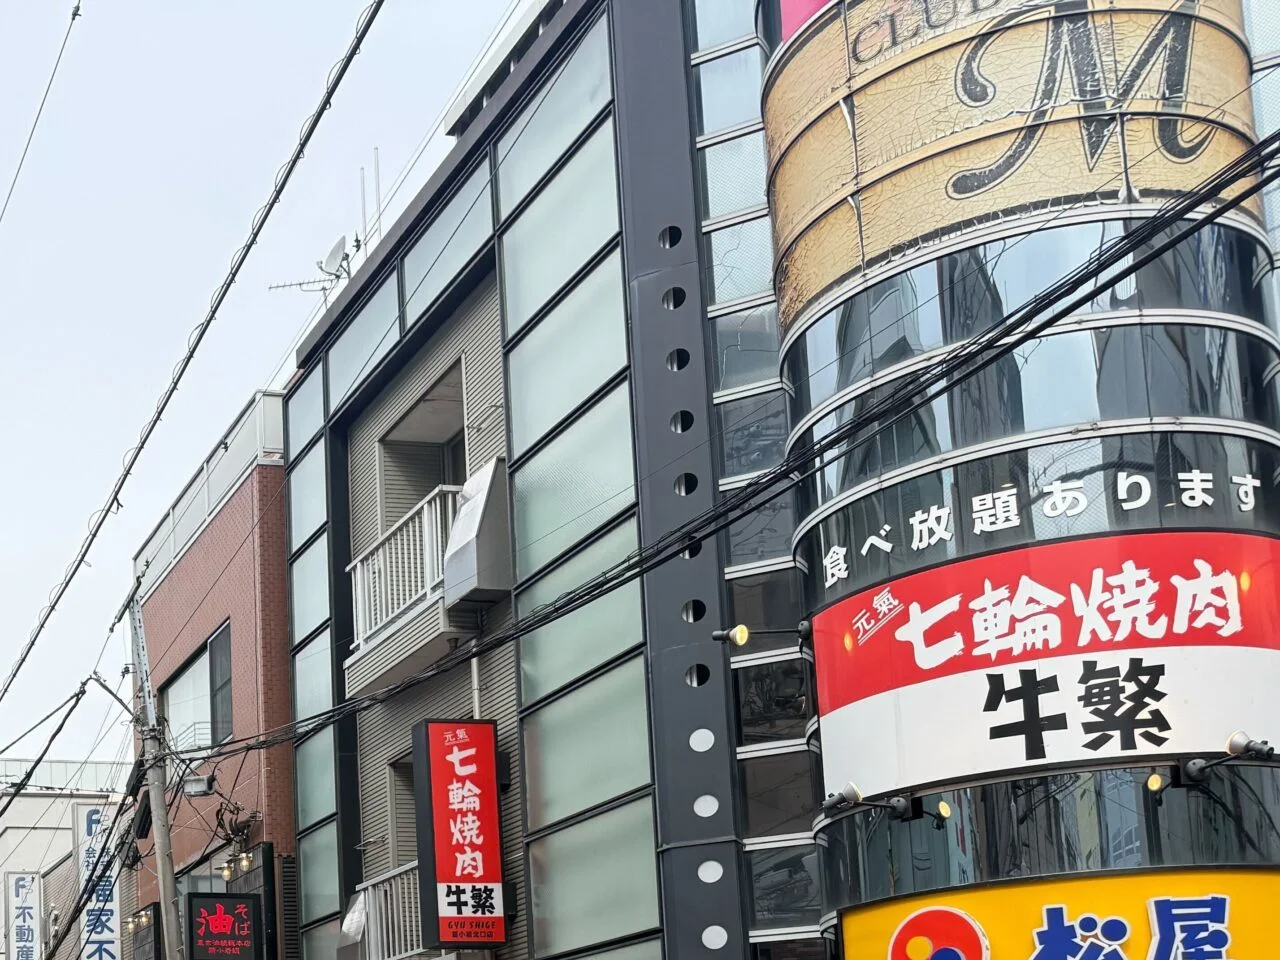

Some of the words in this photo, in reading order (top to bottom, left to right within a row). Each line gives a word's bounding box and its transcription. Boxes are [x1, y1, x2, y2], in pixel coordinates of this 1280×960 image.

[822, 469, 1261, 589] 食べ放題あります
[895, 559, 1243, 670] 七輪焼肉
[982, 657, 1172, 761] 牛繁
[445, 745, 484, 878] 七輪焼肉
[446, 885, 495, 915] 牛繁
[448, 921, 466, 929] GYU
[469, 920, 497, 929] SHIGE
